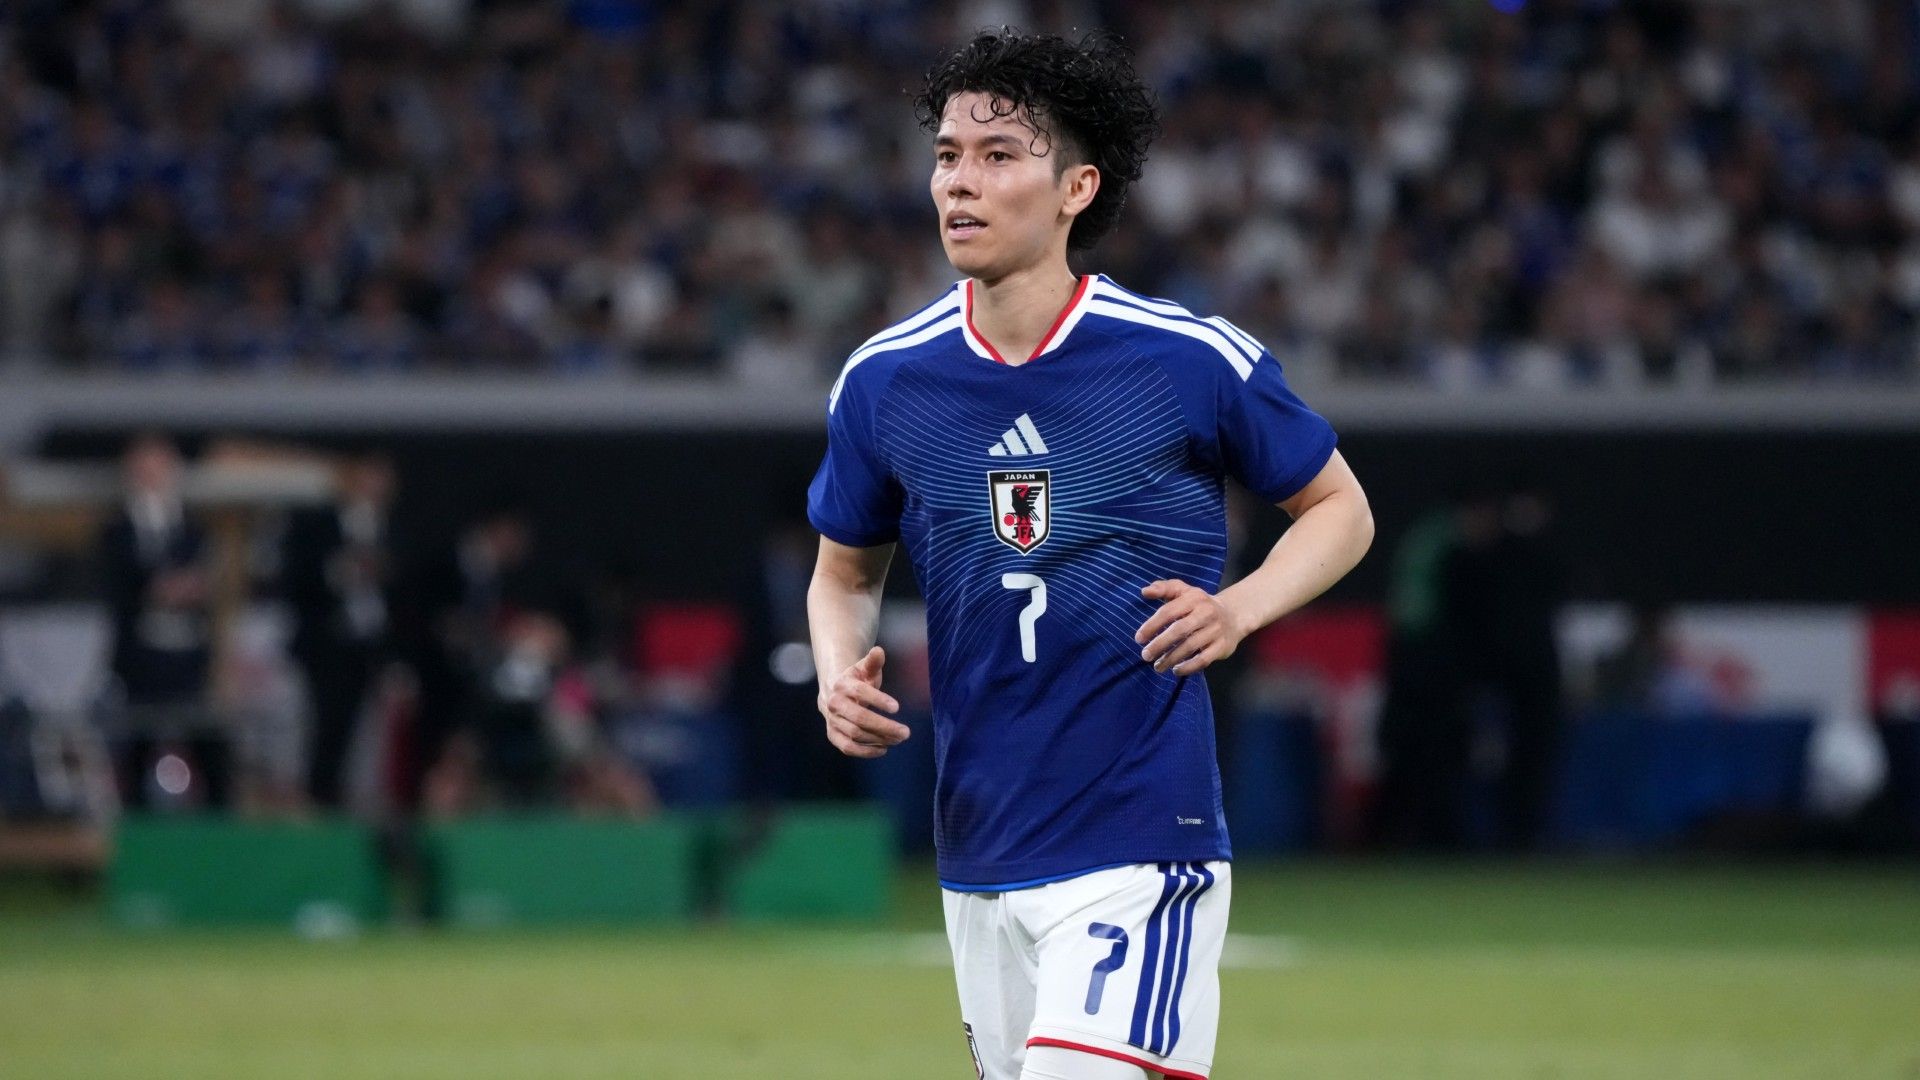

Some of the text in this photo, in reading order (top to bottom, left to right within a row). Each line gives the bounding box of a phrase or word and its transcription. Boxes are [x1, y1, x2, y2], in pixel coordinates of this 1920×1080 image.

[1012, 526, 1036, 539] JFA
[1002, 573, 1047, 663] 7
[1084, 921, 1129, 1016] 7
